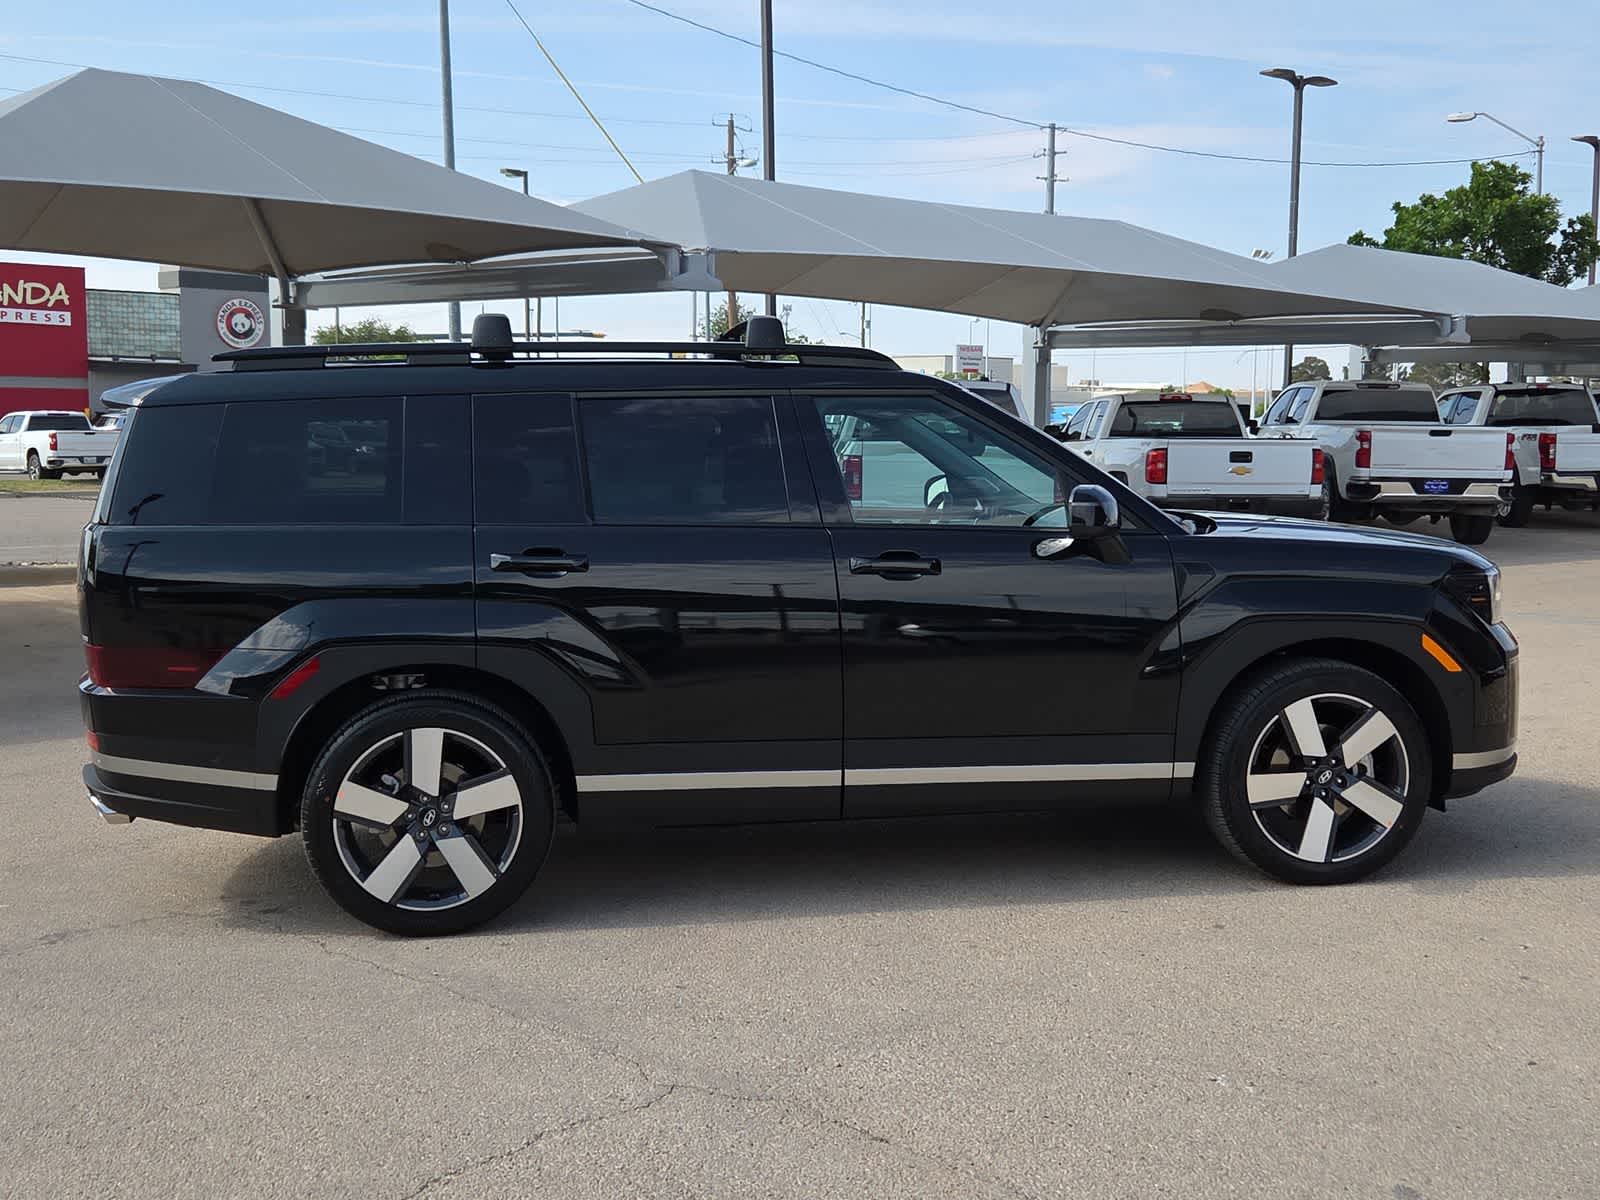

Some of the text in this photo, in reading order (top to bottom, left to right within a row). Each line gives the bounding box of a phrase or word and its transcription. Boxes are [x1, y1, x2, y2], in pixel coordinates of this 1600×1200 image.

[0, 280, 70, 307] NDA
[219, 300, 264, 325] PANDA EXPRESS
